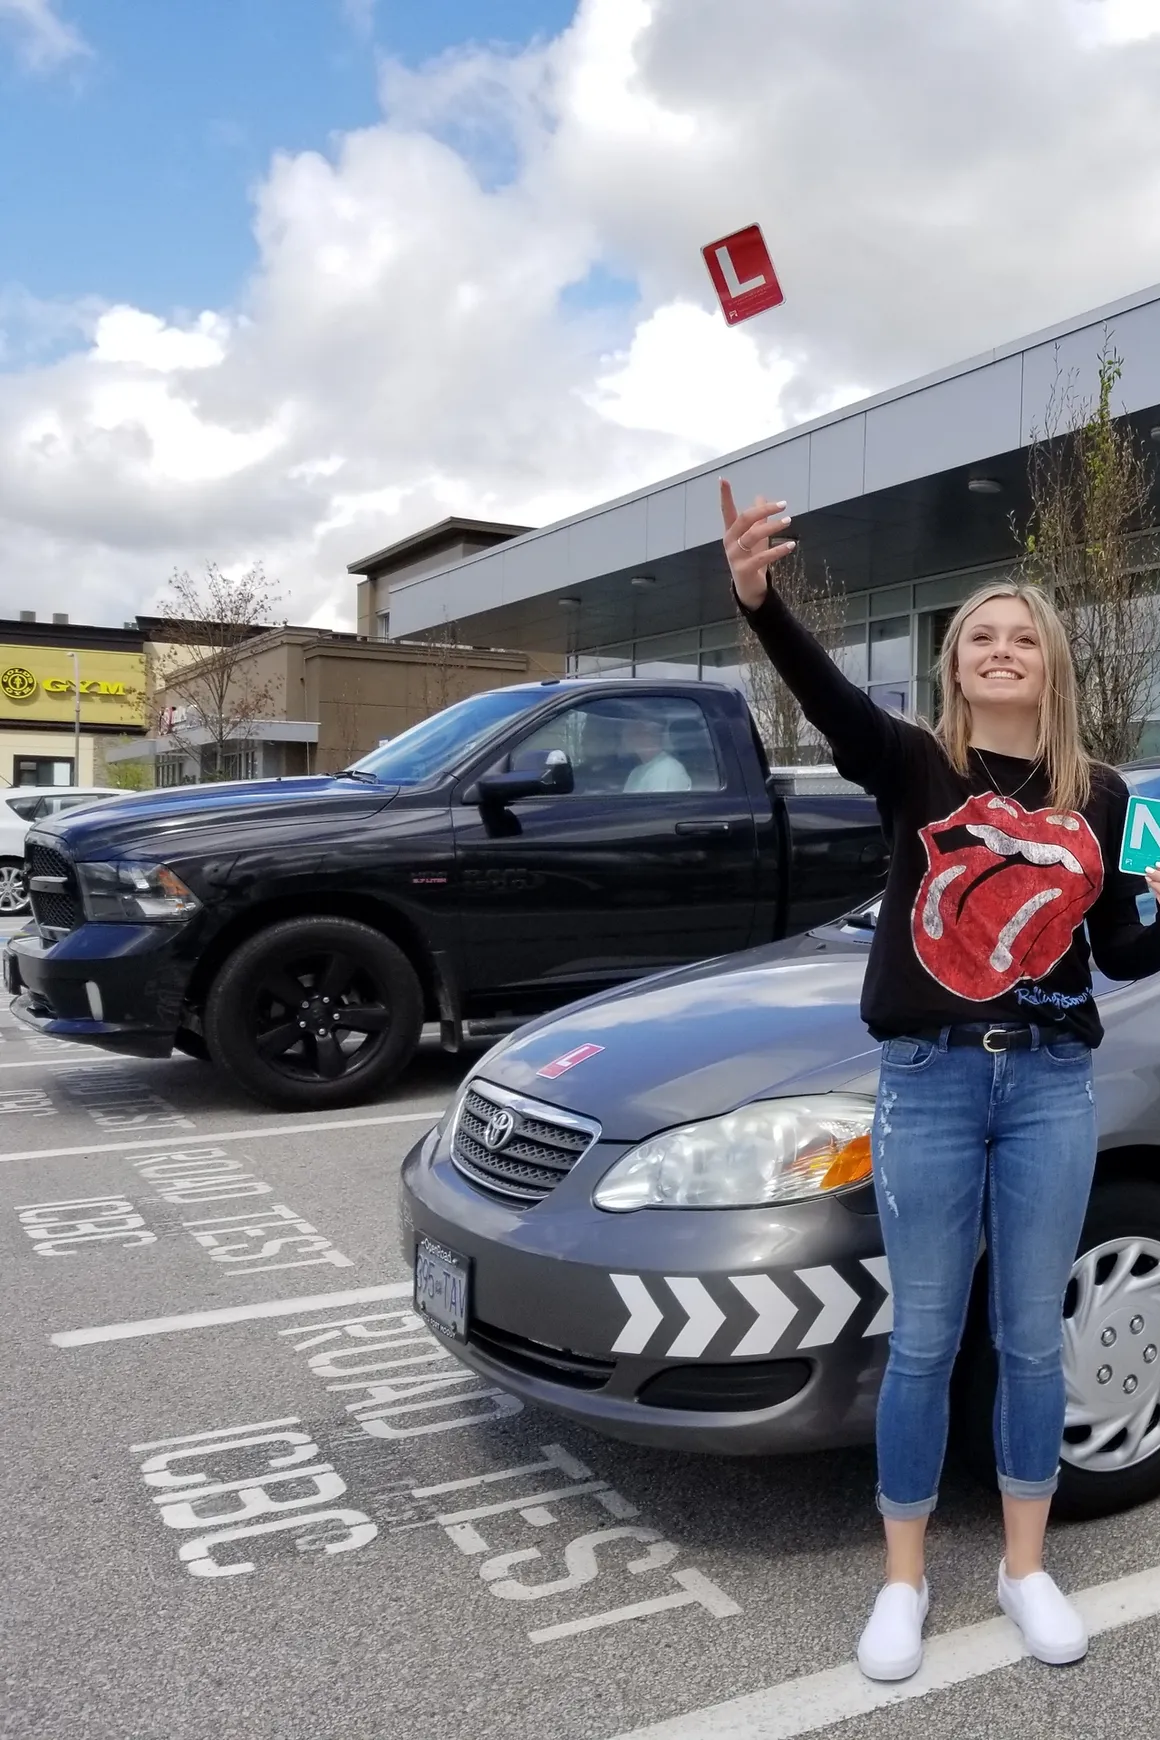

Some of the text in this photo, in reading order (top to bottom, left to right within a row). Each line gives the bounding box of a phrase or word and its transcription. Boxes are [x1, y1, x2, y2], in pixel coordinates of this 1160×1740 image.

[715, 245, 766, 298] L
[42, 679, 126, 695] GYM
[14, 1195, 157, 1256] ICBC
[125, 1147, 355, 1276] ROAD TEST
[130, 1416, 379, 1577] ICBC
[279, 1310, 743, 1644] ROAD TEST
